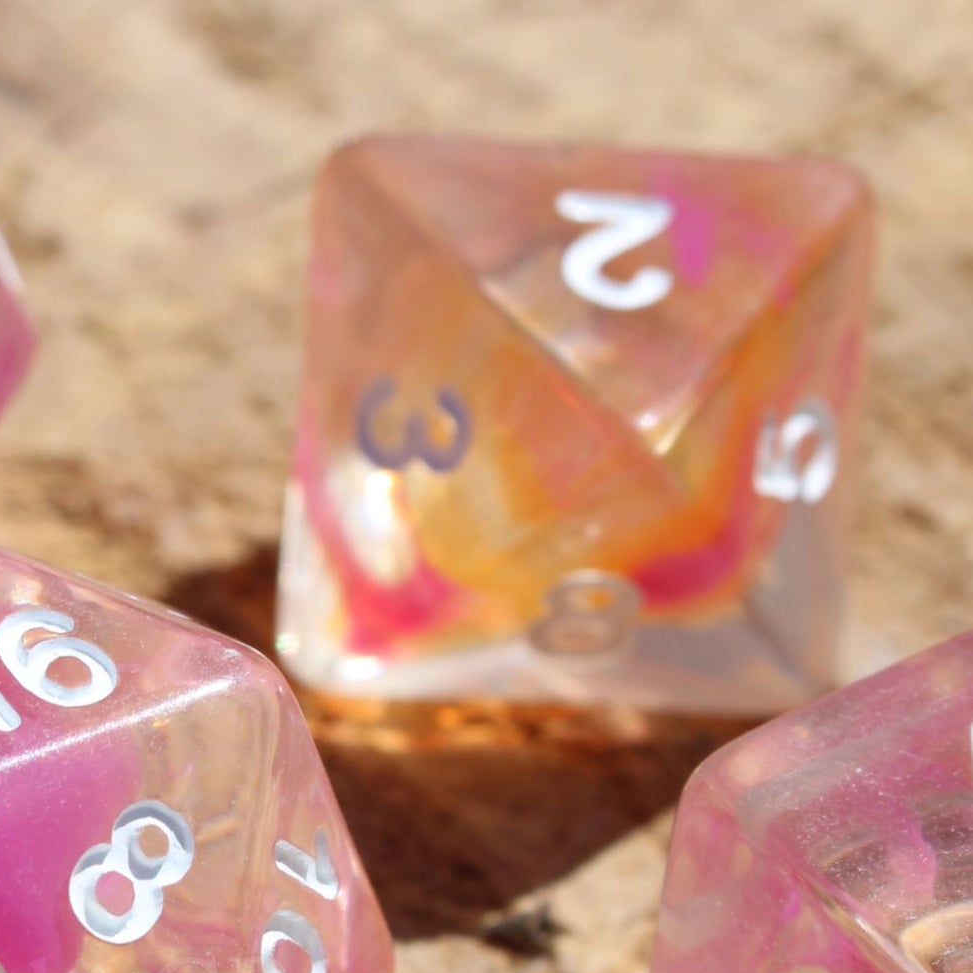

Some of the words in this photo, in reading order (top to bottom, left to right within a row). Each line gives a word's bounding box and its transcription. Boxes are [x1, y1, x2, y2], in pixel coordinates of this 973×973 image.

[556, 188, 674, 310] 2
[353, 376, 473, 473] 3
[68, 799, 195, 945] 8
